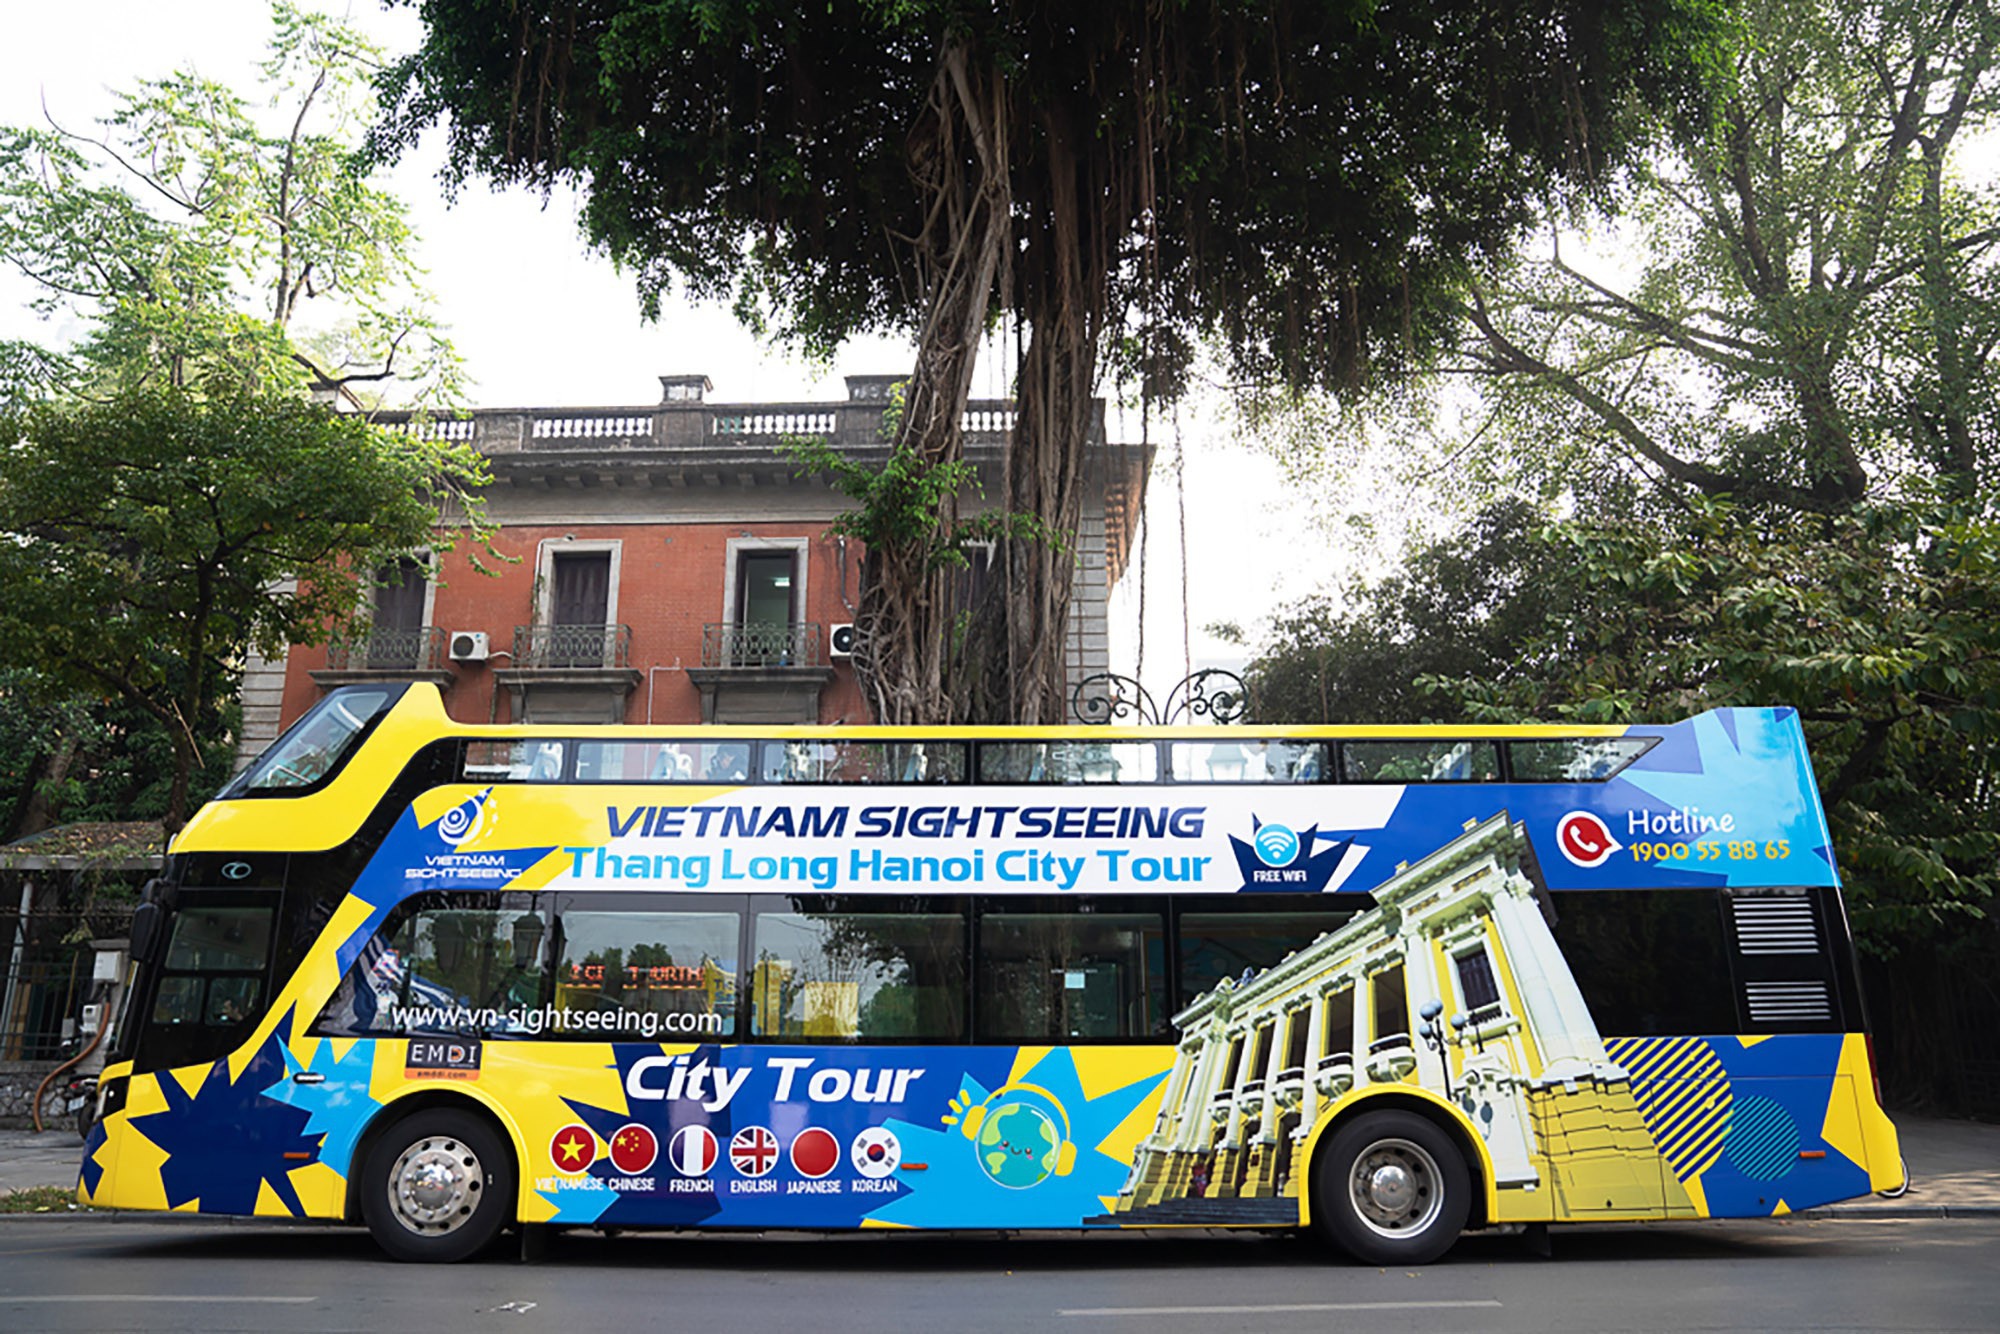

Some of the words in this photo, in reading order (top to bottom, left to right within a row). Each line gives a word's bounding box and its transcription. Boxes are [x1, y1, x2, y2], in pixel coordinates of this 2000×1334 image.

[606, 806, 850, 838] VIETNAM
[855, 806, 1207, 838] SIGHTSEEING
[1627, 806, 1735, 835] Hotline
[425, 855, 505, 866] VIETNAM
[1629, 841, 1689, 862] 1900
[1697, 841, 1721, 861] 55
[1727, 840, 1757, 861] 88
[1764, 839, 1791, 860] 65
[405, 868, 522, 879] SIGHTSEEING
[563, 846, 711, 888] Thang
[721, 848, 838, 889] Long
[849, 849, 984, 882] Hanoi
[995, 850, 1086, 890] City
[1096, 849, 1212, 882] Tour
[1253, 870, 1281, 882] FREE
[1282, 870, 1307, 882] WIFI
[391, 1003, 723, 1037] www.vn-sightseeing.com
[626, 1055, 753, 1112] City
[766, 1057, 926, 1103] Tour
[535, 1177, 605, 1191] VIETNAMESE
[608, 1177, 655, 1191] CHINESE
[669, 1178, 715, 1193] FRENCH
[730, 1179, 777, 1193] ENGLISH
[787, 1179, 842, 1194] JAPANESE
[852, 1179, 898, 1193] KOREAN
